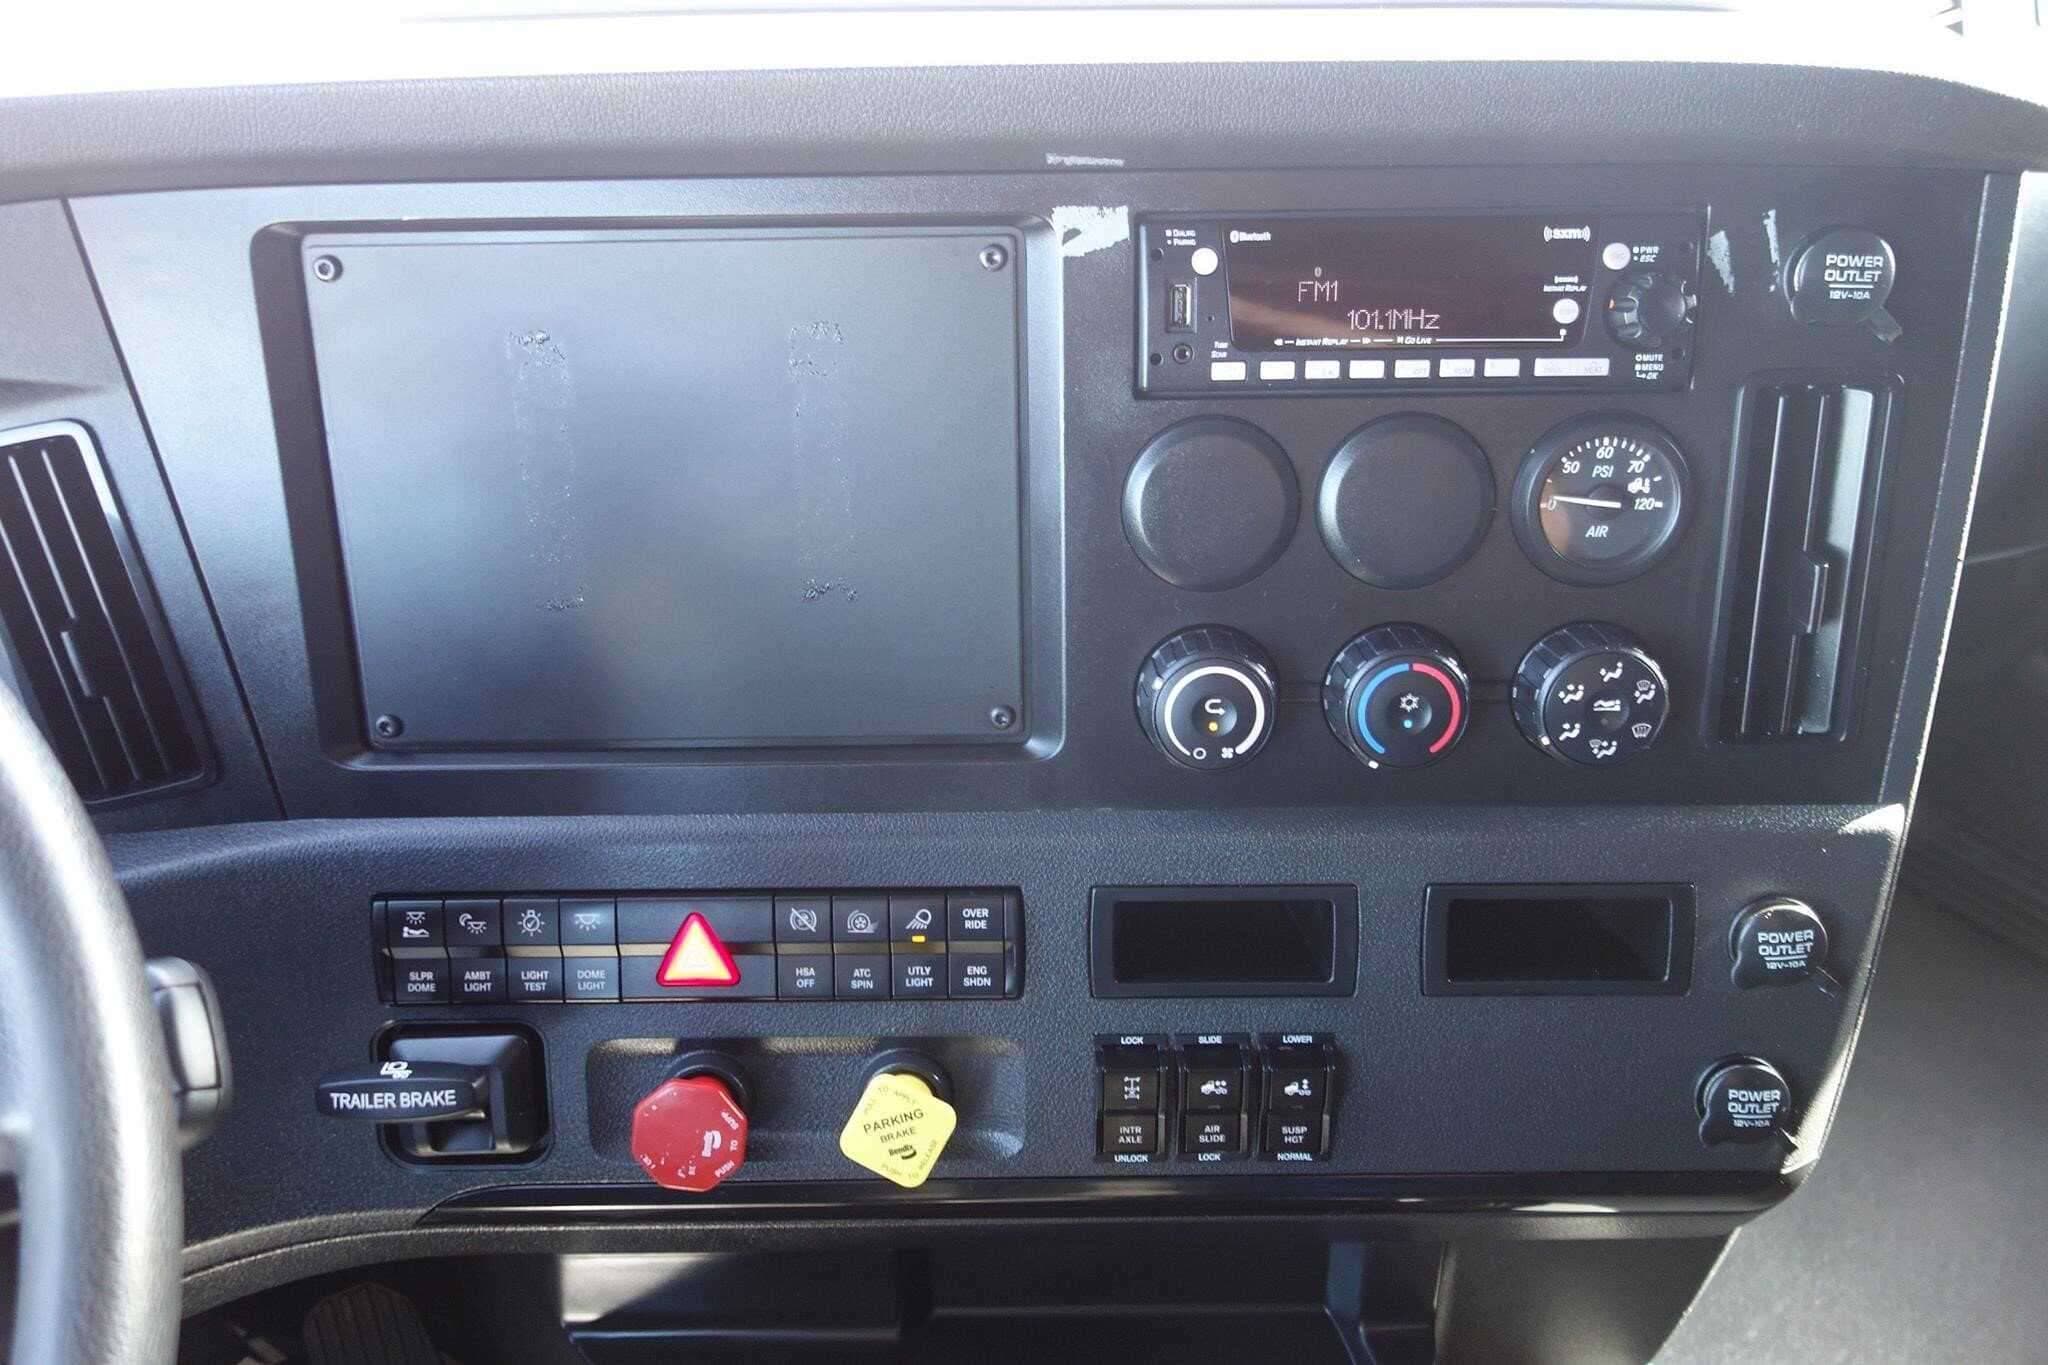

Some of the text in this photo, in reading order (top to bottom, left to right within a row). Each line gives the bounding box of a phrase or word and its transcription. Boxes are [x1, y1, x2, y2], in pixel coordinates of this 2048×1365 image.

[1826, 254, 1884, 268] POWER
[1824, 269, 1882, 282] OUTLET
[1298, 280, 1338, 302] FM1
[1829, 290, 1871, 300] 12V-10A
[1347, 308, 1440, 330] 101.1MHz
[1642, 353, 1664, 362] MUTE
[1642, 363, 1664, 372] MENU
[1596, 446, 1614, 460] 60
[1562, 461, 1580, 474] 50
[1627, 460, 1645, 473] 70
[1592, 466, 1614, 478] PSI
[1634, 498, 1654, 510] 120
[1585, 526, 1608, 538] AIR
[962, 908, 989, 918] OVER
[965, 919, 987, 929] RIDE
[1757, 930, 1814, 944] POWER
[1758, 942, 1814, 956] OUTLET
[409, 971, 433, 981] SLPR
[464, 971, 491, 981] AMBT
[521, 971, 549, 981] LIGHT
[577, 970, 606, 980] DOME
[796, 968, 815, 977] HSA
[853, 968, 871, 978] ATC
[908, 966, 931, 976] UTLY
[967, 966, 987, 976] ENG
[577, 981, 606, 991] LIGHT
[796, 978, 815, 988] OFF
[851, 979, 874, 989] SPIN
[906, 977, 934, 987] LIGHT
[963, 976, 991, 987] SHDN
[408, 982, 436, 992] DOME
[464, 982, 491, 992] LIGHT
[524, 982, 546, 992] TEST
[1121, 1036, 1143, 1045] LOCK
[1198, 1035, 1222, 1044] SLIDE
[1282, 1035, 1313, 1044] LOWER
[330, 1089, 457, 1110] TRAILER BRAKE
[1728, 1089, 1781, 1102] POWER
[1728, 1101, 1780, 1113] OUTLET
[863, 1108, 924, 1134] PARKING
[1119, 1126, 1142, 1135] INTR
[1204, 1125, 1221, 1134] AIR
[1281, 1126, 1307, 1135] SUSP
[880, 1126, 917, 1144] BRAKE
[1118, 1135, 1143, 1144] AXLE
[1199, 1134, 1226, 1143] SLIDE
[1285, 1135, 1304, 1144] HGT
[888, 1144, 914, 1157] Bendix
[1114, 1154, 1148, 1163] UNLOCK
[1198, 1153, 1221, 1162] LOCK
[1277, 1152, 1313, 1162] NORMAL
